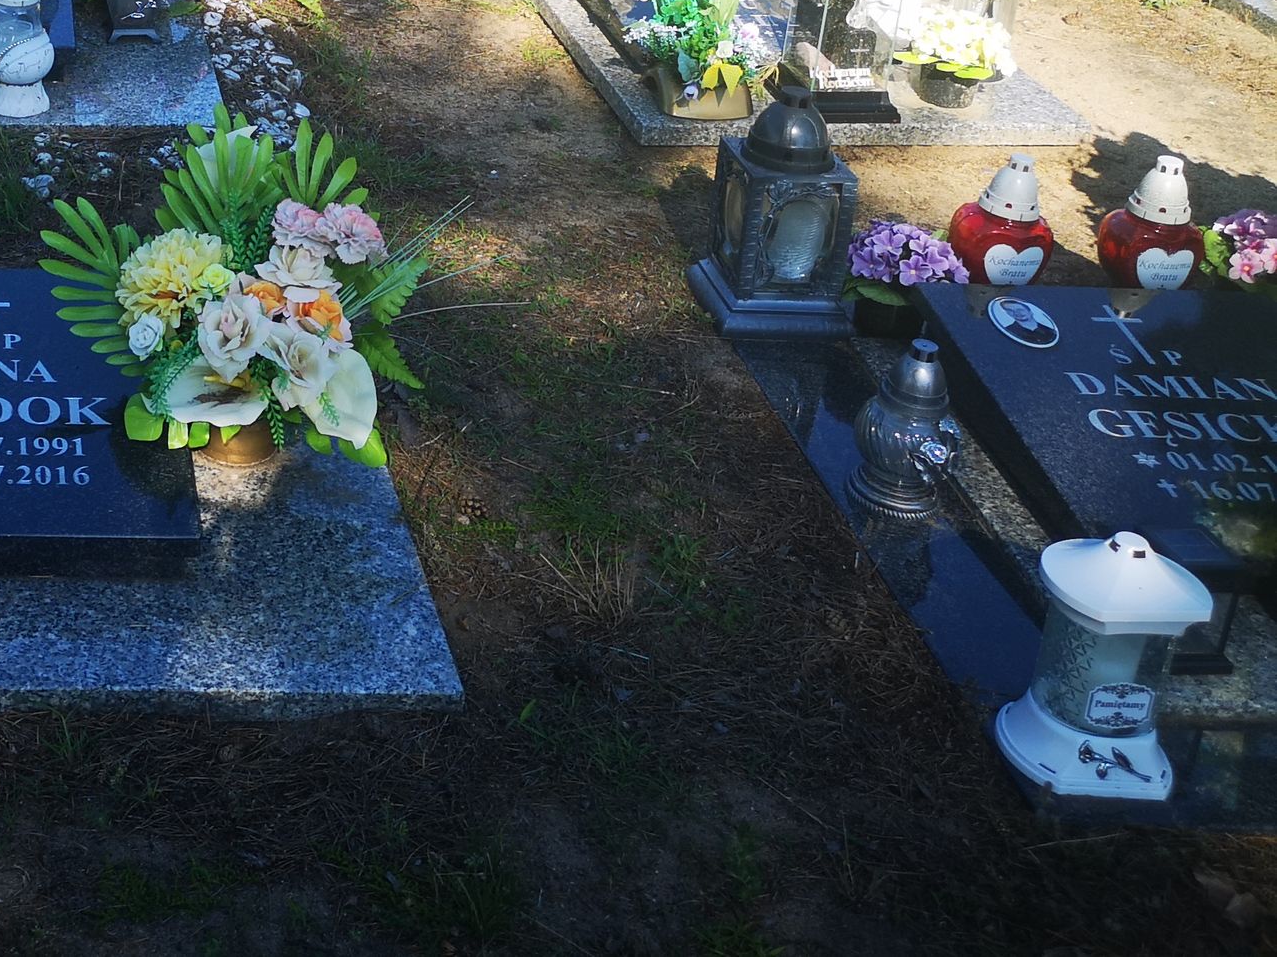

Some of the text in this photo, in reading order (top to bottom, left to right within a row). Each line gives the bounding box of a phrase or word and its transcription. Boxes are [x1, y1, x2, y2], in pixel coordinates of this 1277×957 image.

[999, 268, 1028, 278] Bratu
[1150, 273, 1179, 282] Bratu
[3, 333, 22, 349] P
[1160, 349, 1183, 366] P
[1063, 372, 1277, 401] DAMIAN
[1094, 699, 1146, 711] Pamiętamy
